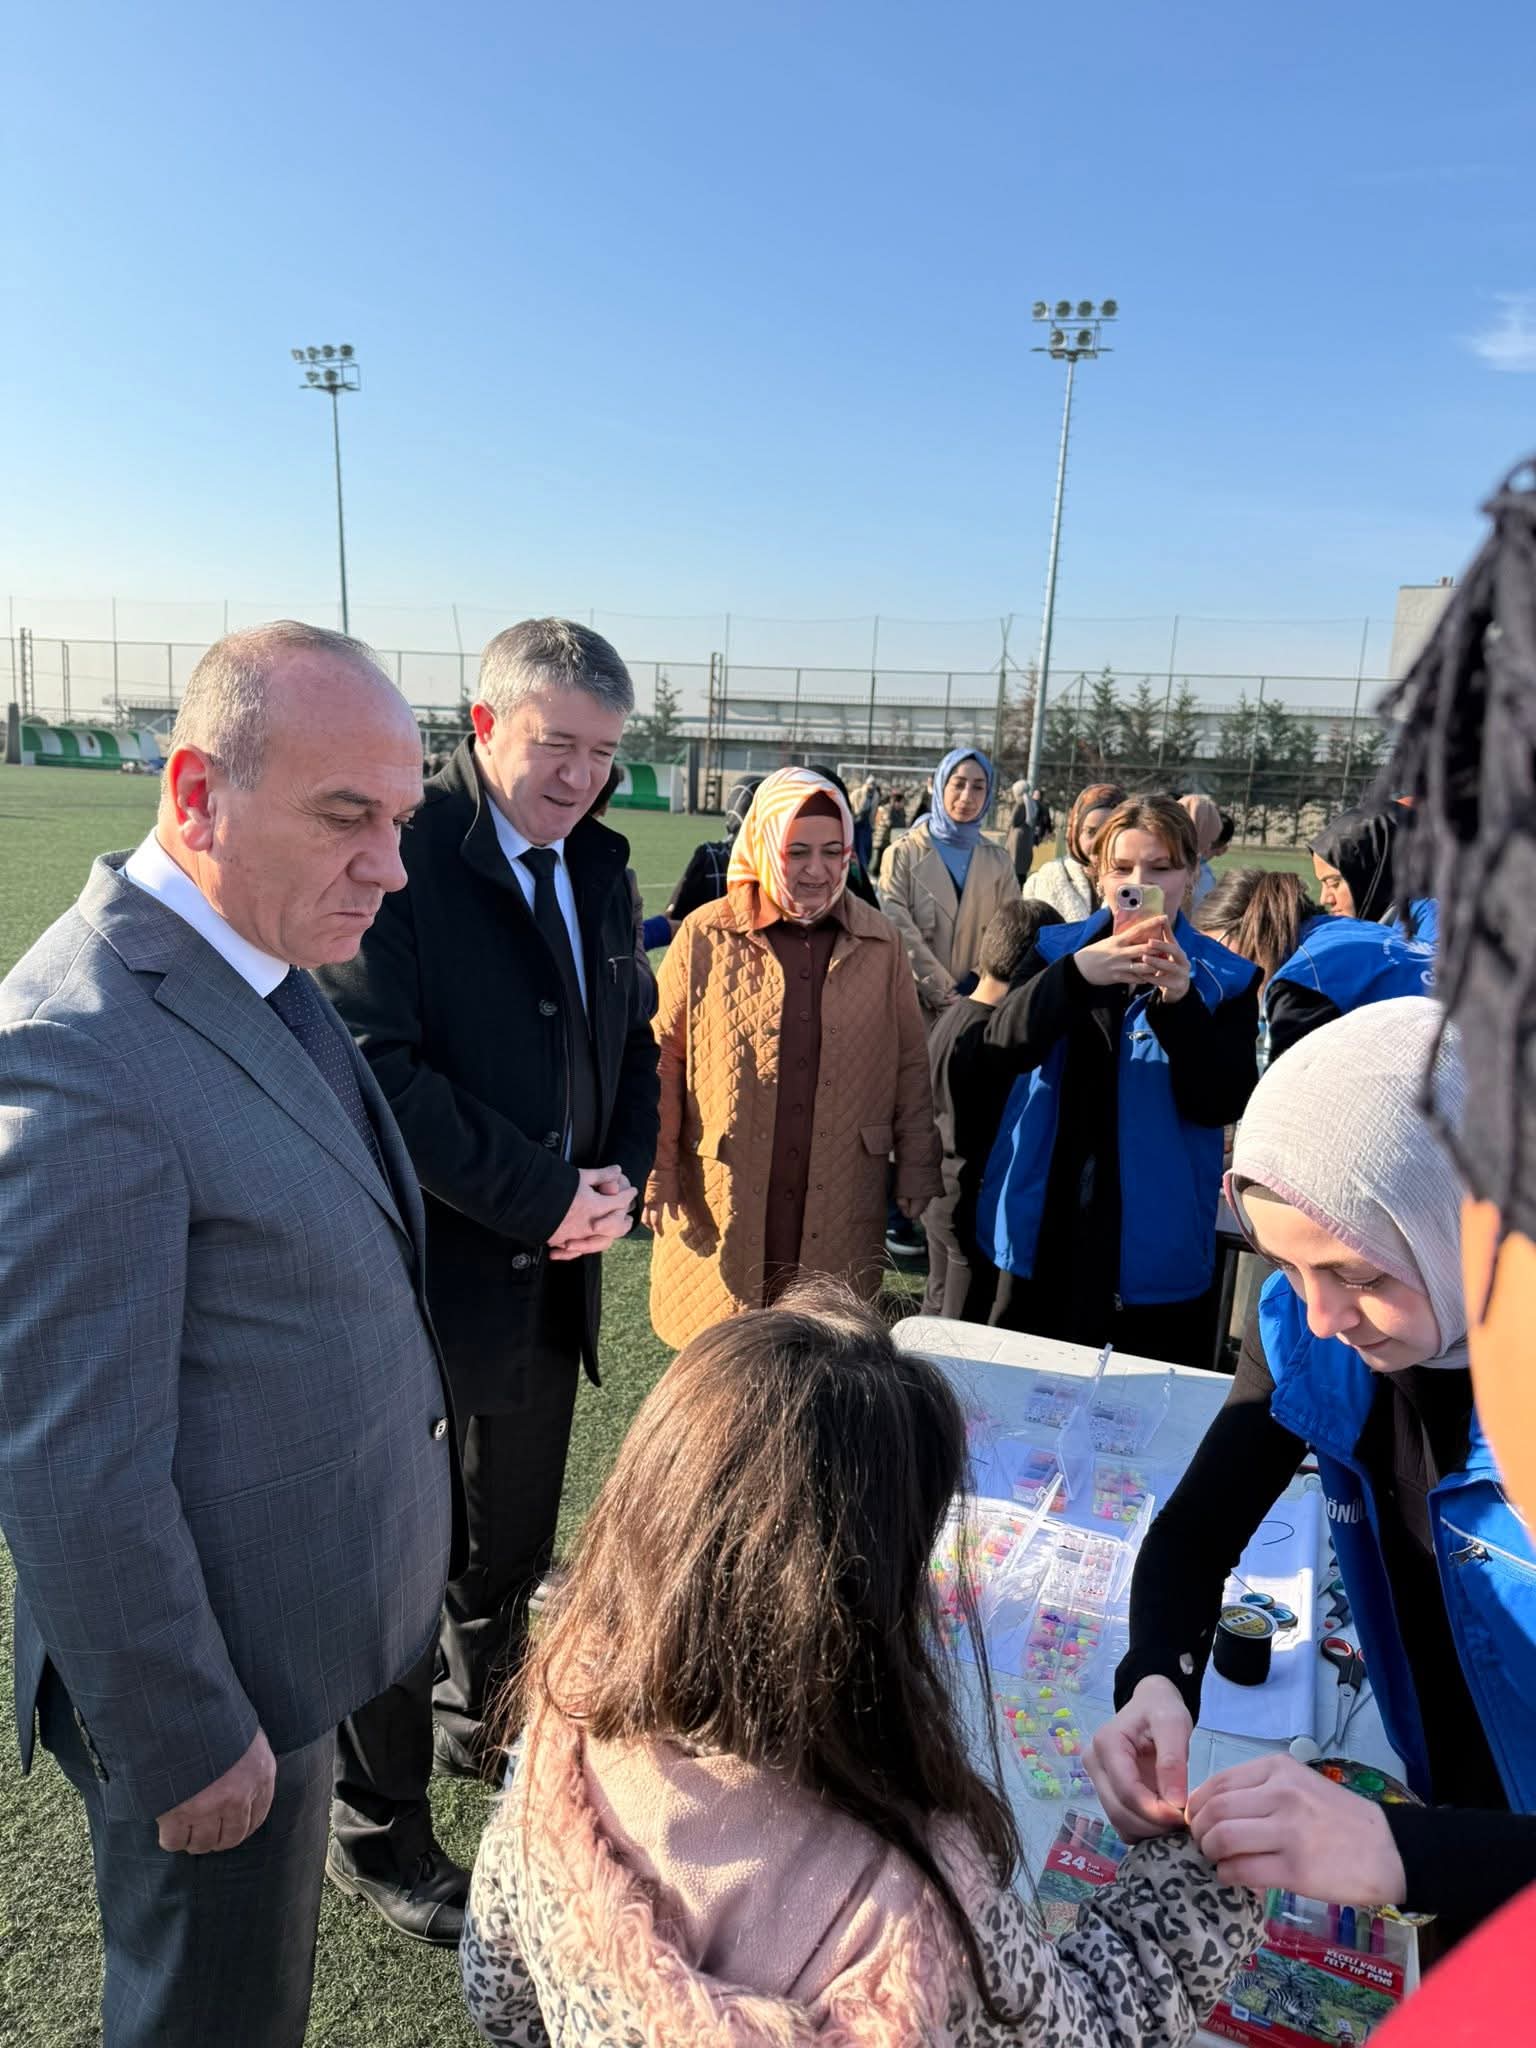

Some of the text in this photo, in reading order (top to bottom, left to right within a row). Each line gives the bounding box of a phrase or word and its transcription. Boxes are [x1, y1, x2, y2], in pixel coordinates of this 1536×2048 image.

[1327, 1497, 1364, 1524] ÖNÜ
[1058, 1850, 1086, 1871] 24
[1324, 1956, 1393, 1987] FELT TIP PENS
[1360, 1962, 1393, 1978] KALEM
